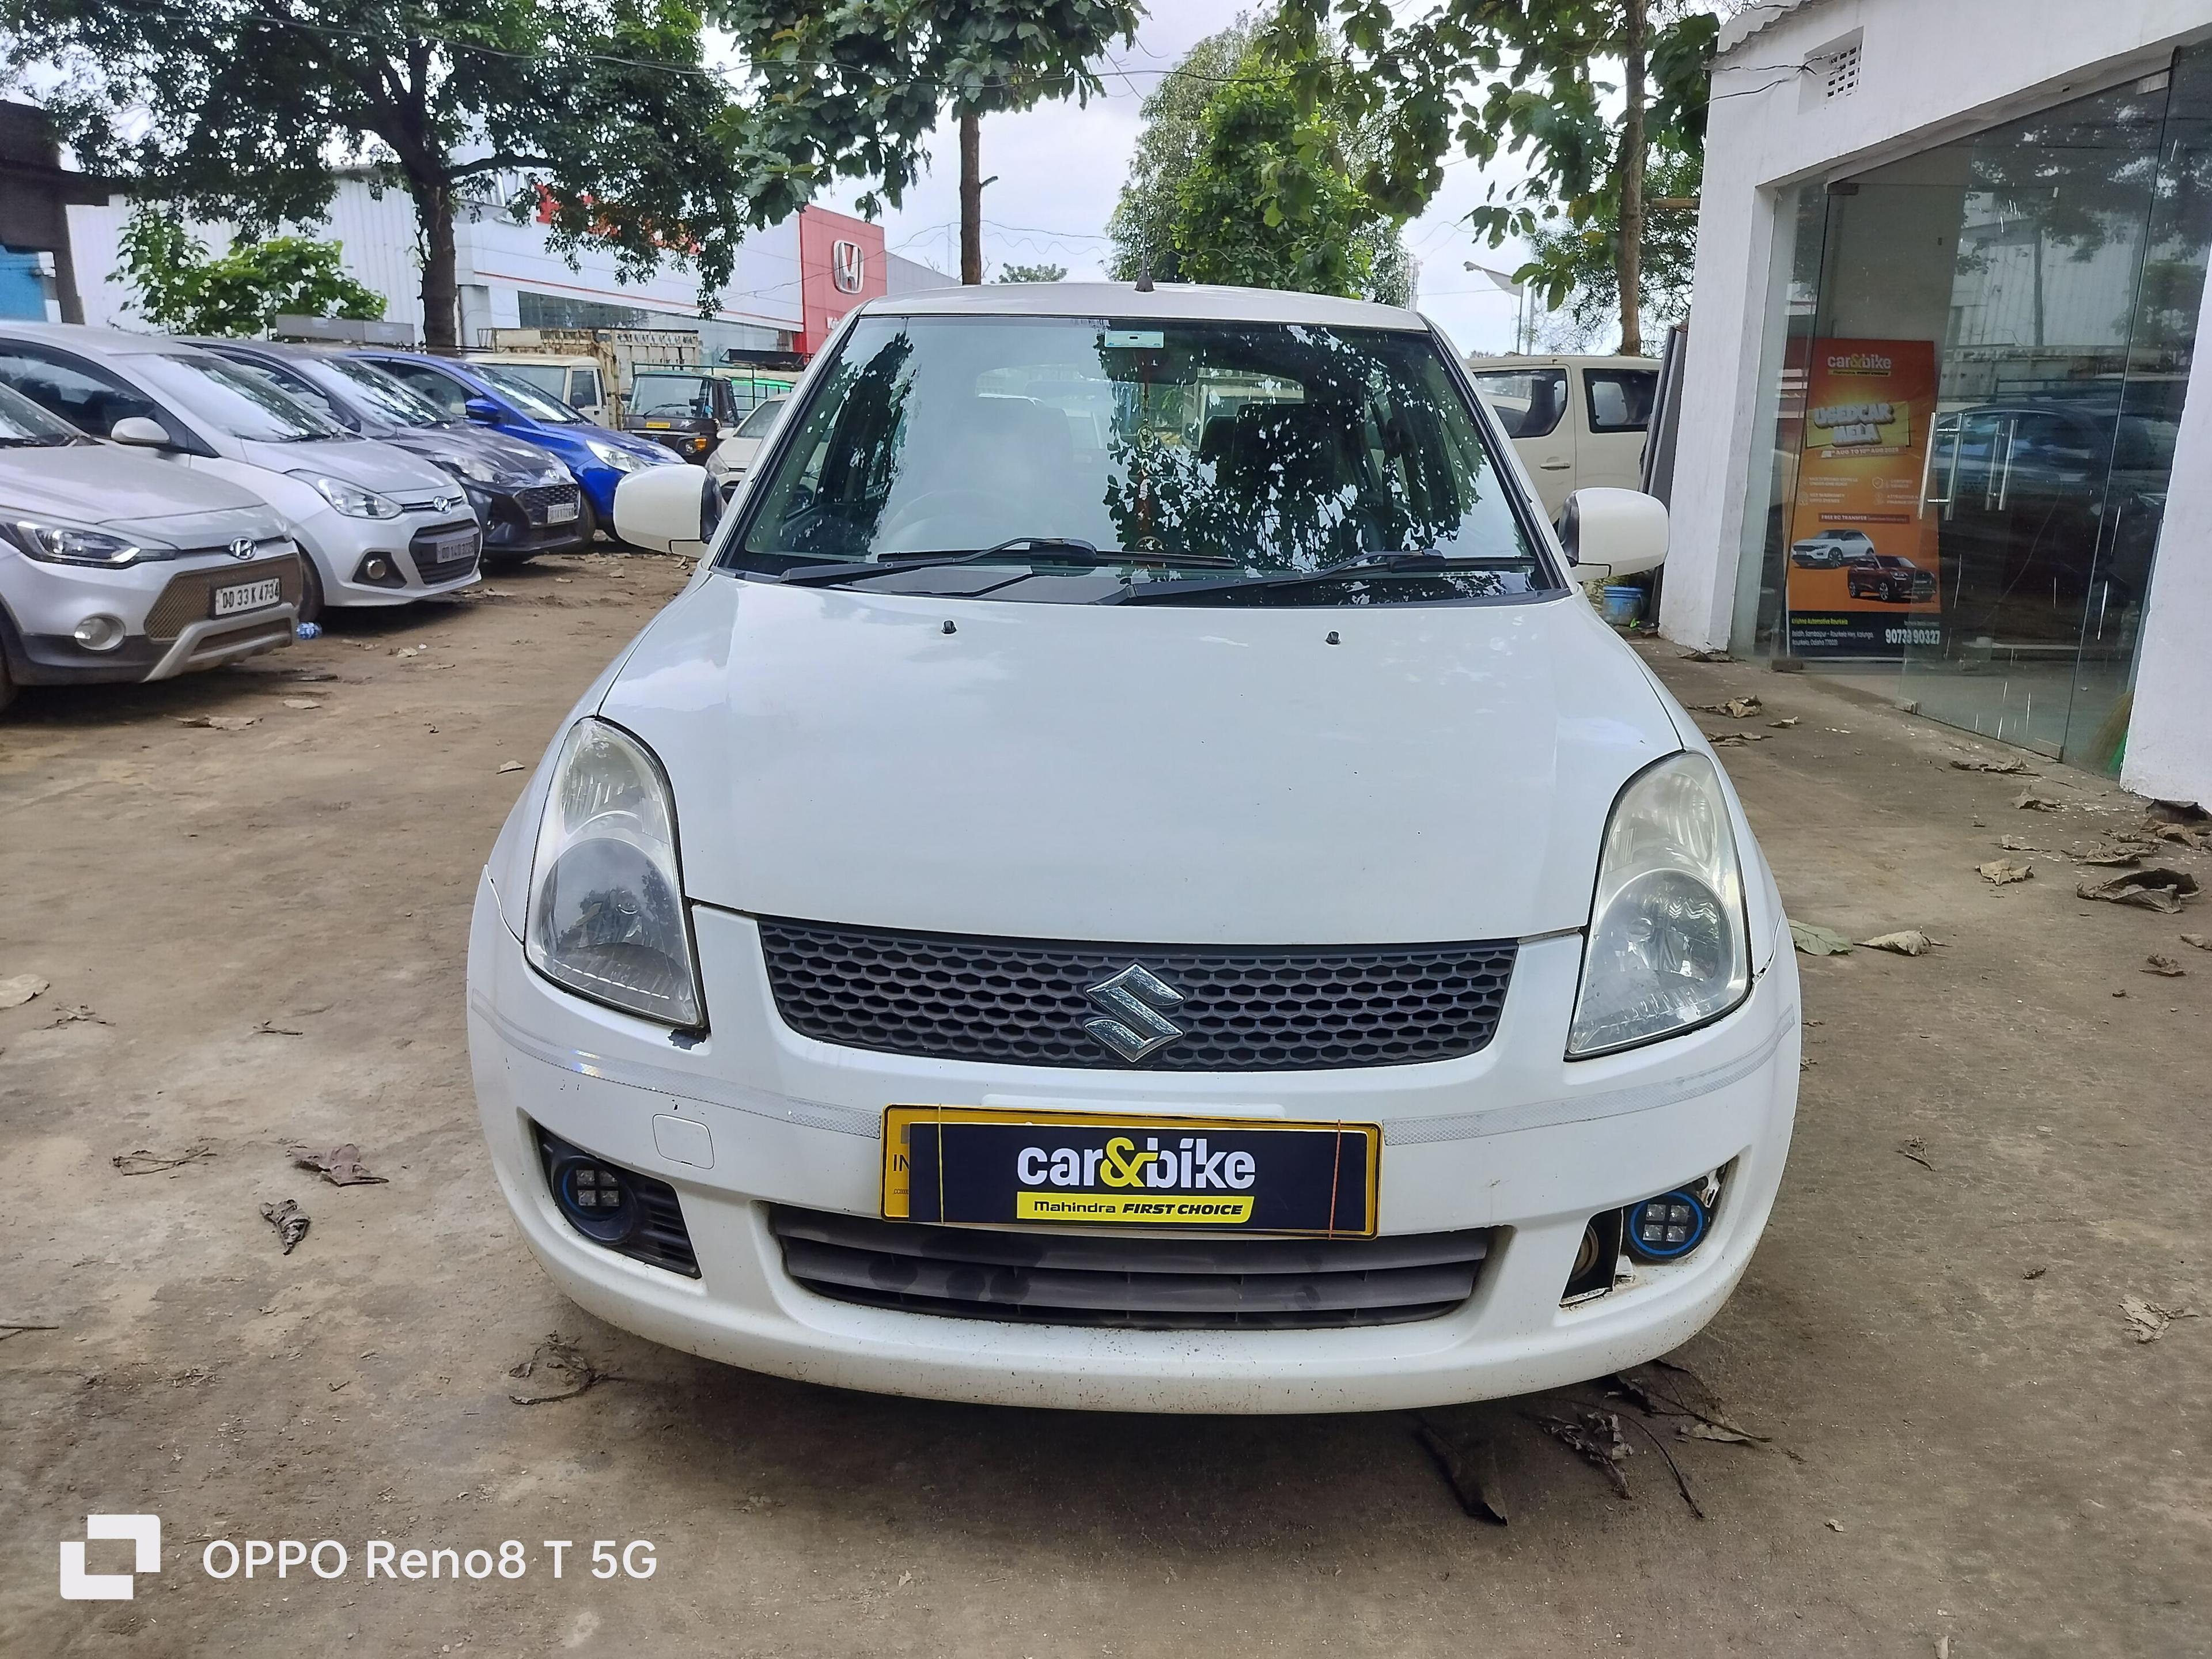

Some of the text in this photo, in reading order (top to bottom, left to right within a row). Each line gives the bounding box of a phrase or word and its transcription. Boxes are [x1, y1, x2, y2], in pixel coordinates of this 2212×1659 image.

[1827, 353, 1892, 369] car&bike
[237, 589, 249, 606] 33
[1913, 629, 1940, 645] 90327
[1017, 1137, 1256, 1190] car&bike
[1034, 1201, 1244, 1215] Mahindra FIRST CHOICE
